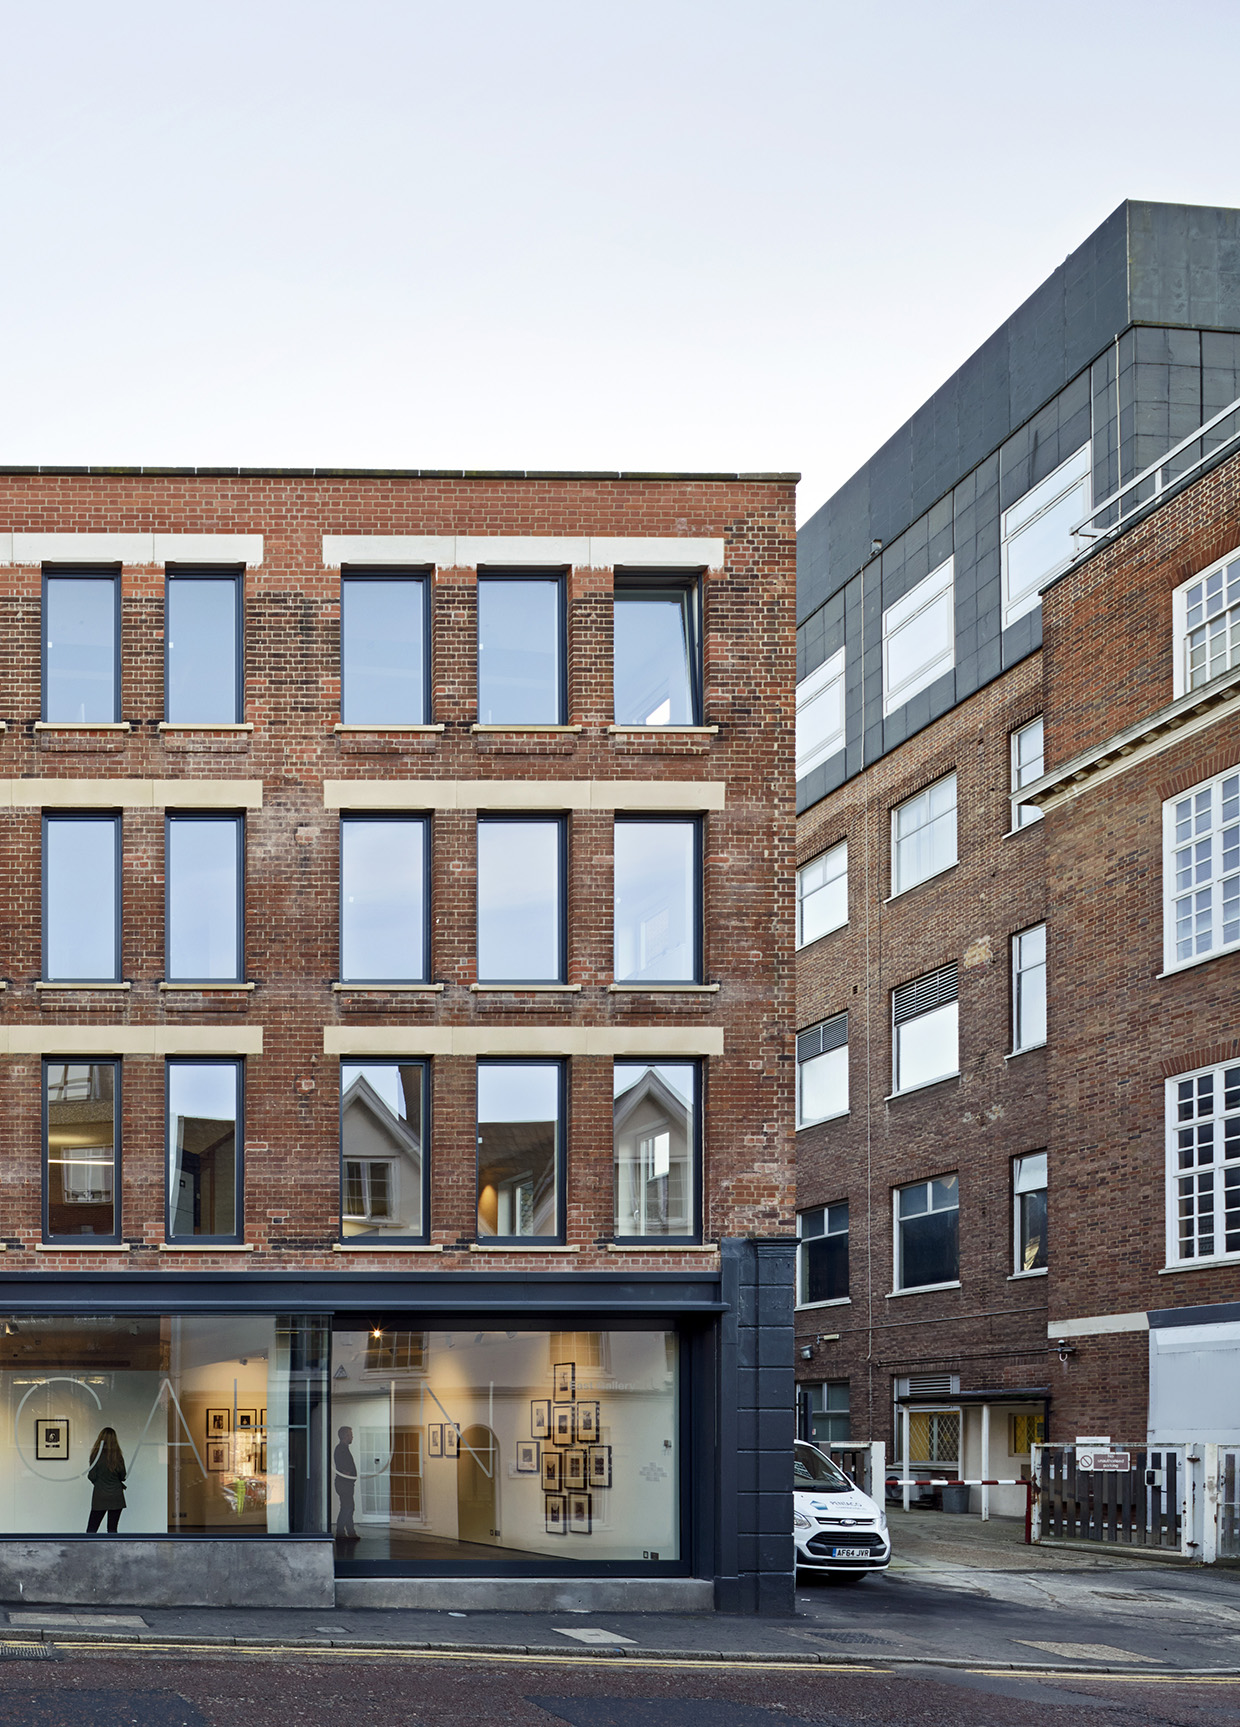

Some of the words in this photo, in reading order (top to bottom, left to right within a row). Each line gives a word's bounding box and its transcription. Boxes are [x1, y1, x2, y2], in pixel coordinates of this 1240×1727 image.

[569, 1381, 593, 1390] East
[596, 1381, 636, 1392] Gallery
[837, 1549, 855, 1557] AF64
[856, 1549, 869, 1557] JVR
